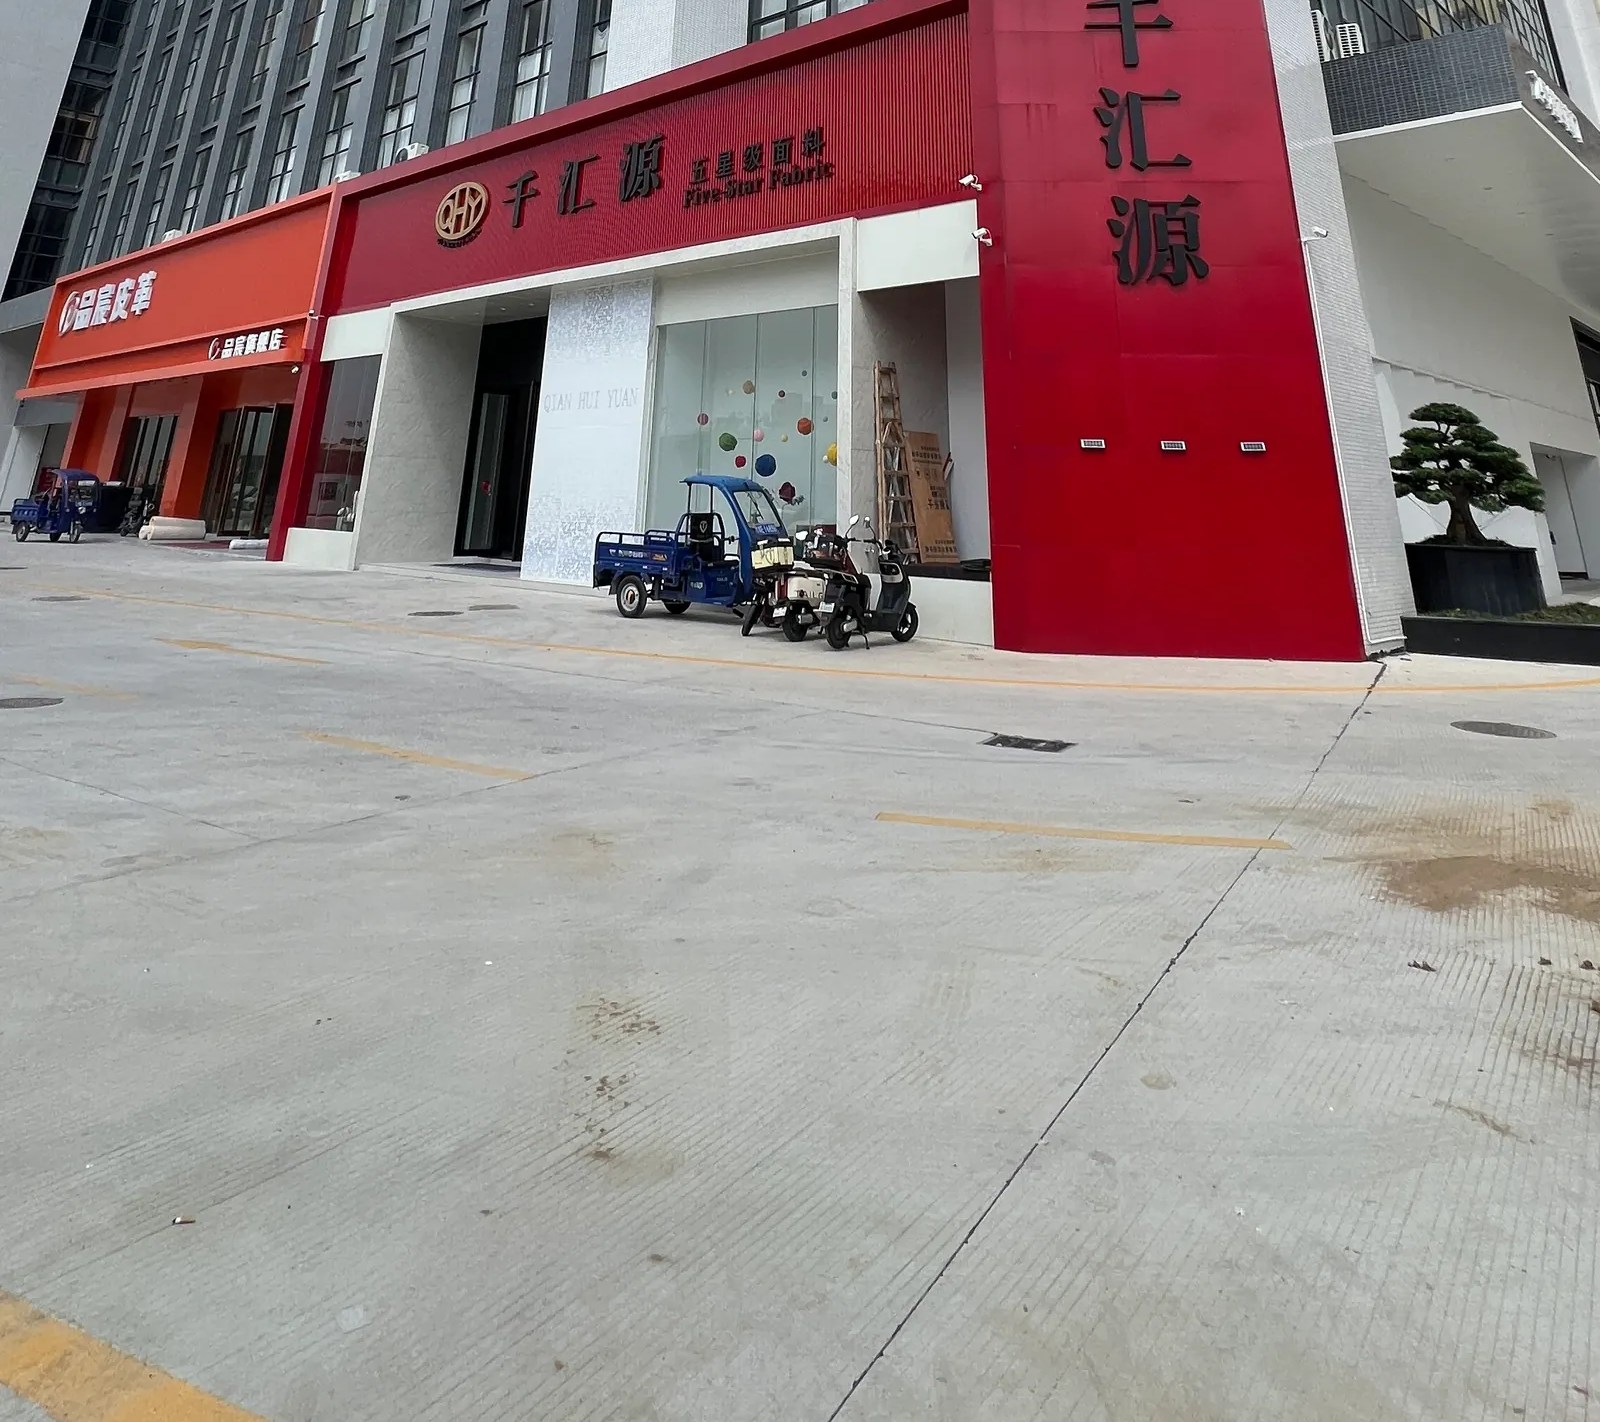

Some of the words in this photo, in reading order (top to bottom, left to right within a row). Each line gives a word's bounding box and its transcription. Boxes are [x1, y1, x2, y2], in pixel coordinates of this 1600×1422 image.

[502, 132, 666, 228] 千汇源
[690, 126, 824, 184] 五星级面料
[683, 178, 764, 208] Five-Star
[769, 159, 834, 190] Fabric
[437, 184, 486, 239] QHY
[543, 392, 573, 413] QIAN
[577, 389, 600, 410] HUI
[607, 386, 640, 408] YUAN
